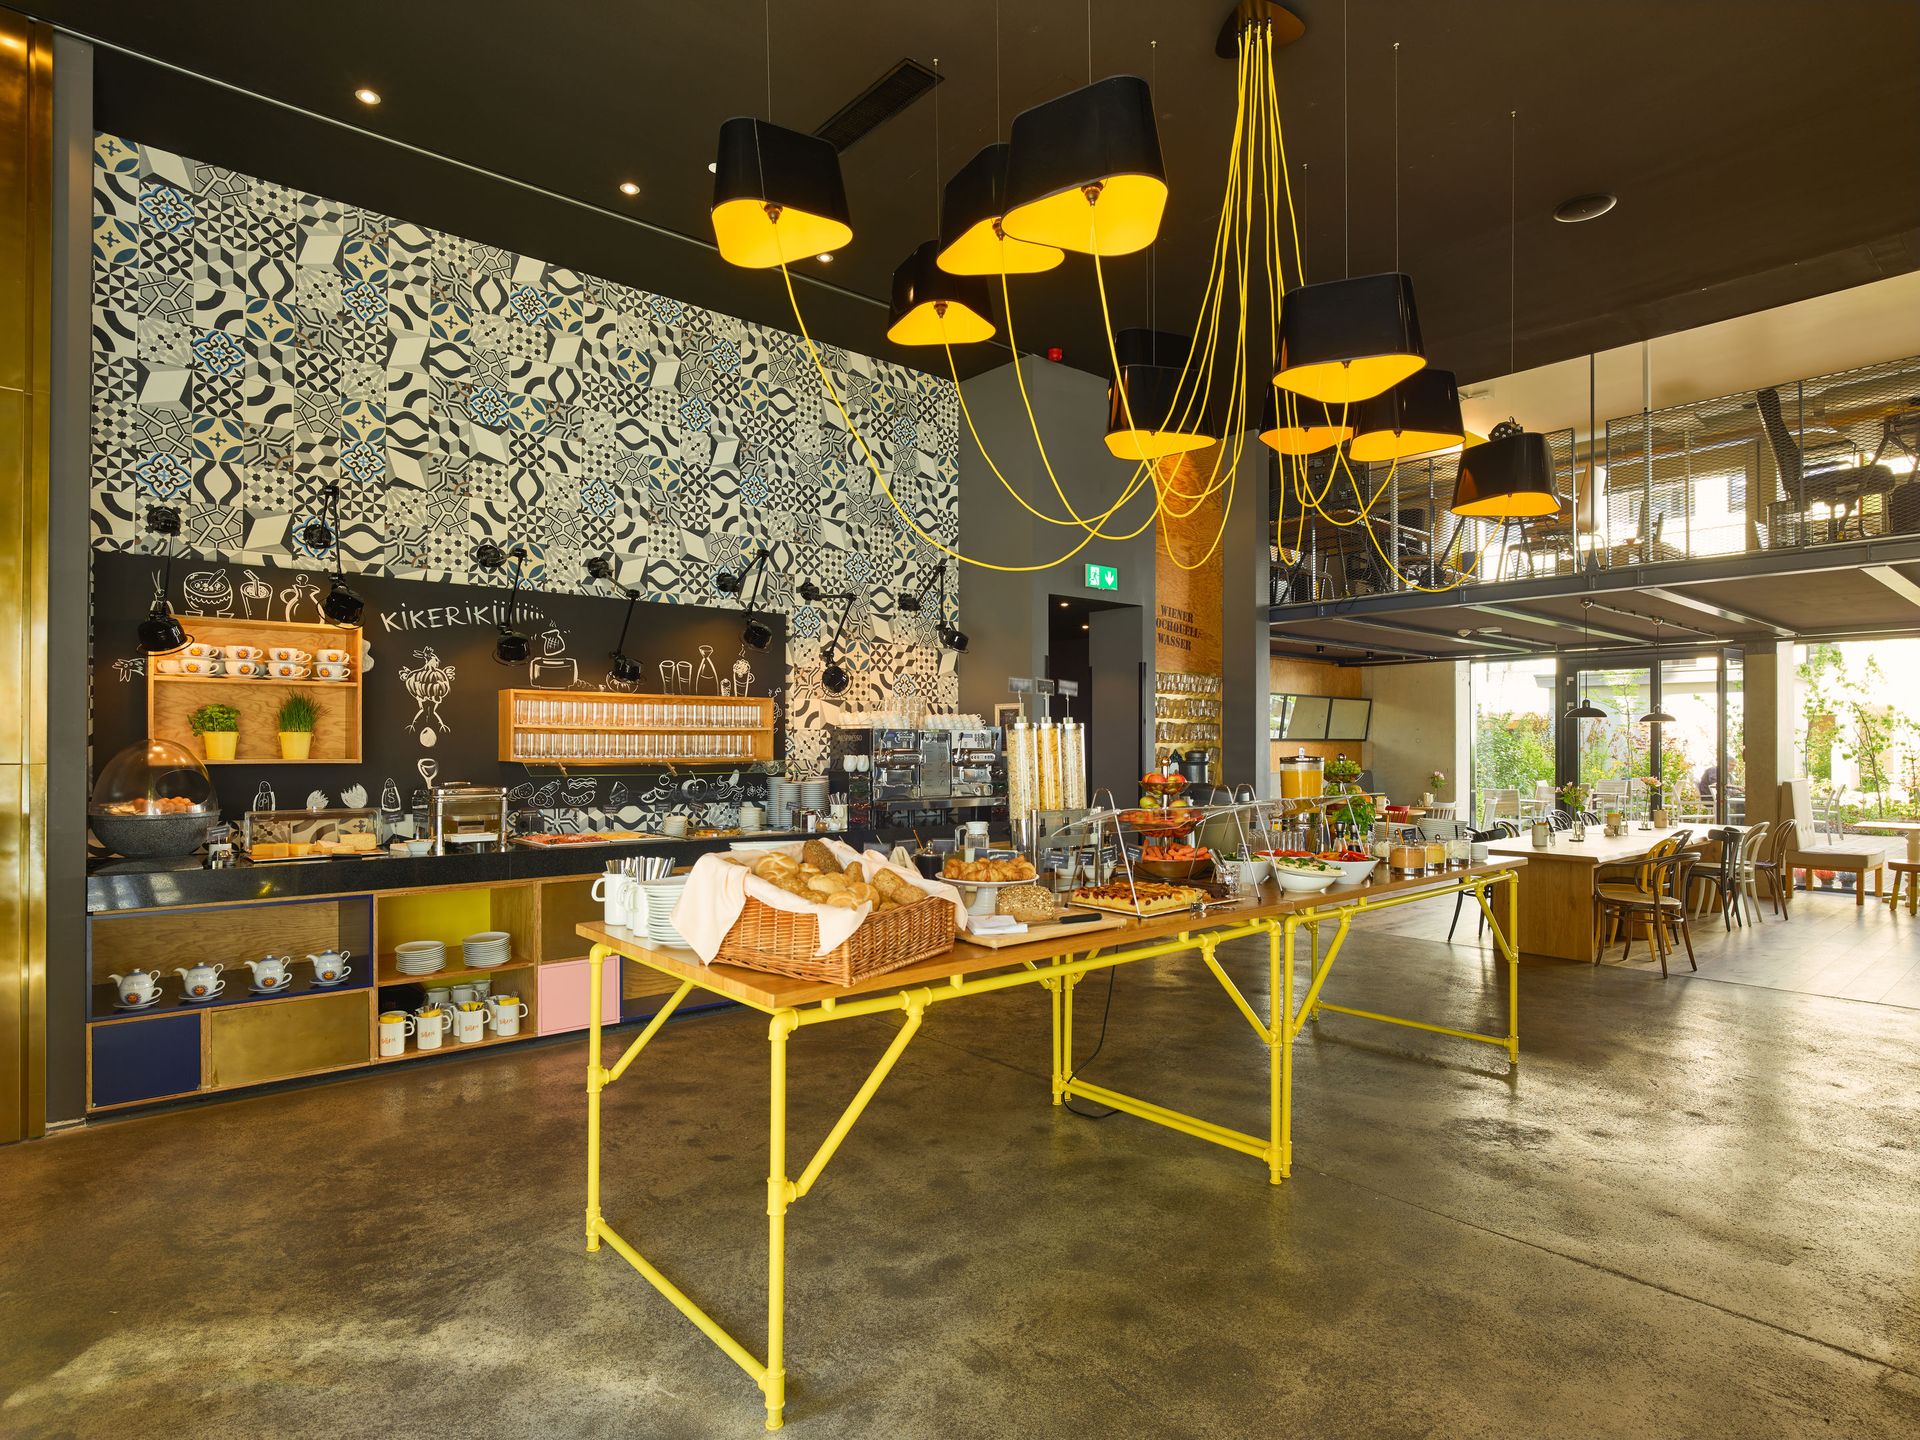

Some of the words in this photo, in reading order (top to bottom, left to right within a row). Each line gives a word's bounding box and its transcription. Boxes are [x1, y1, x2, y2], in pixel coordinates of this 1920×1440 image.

[1161, 604, 1193, 623] WIENER
[1156, 618, 1200, 638] OCHQUELL
[1158, 632, 1191, 651] WASSER
